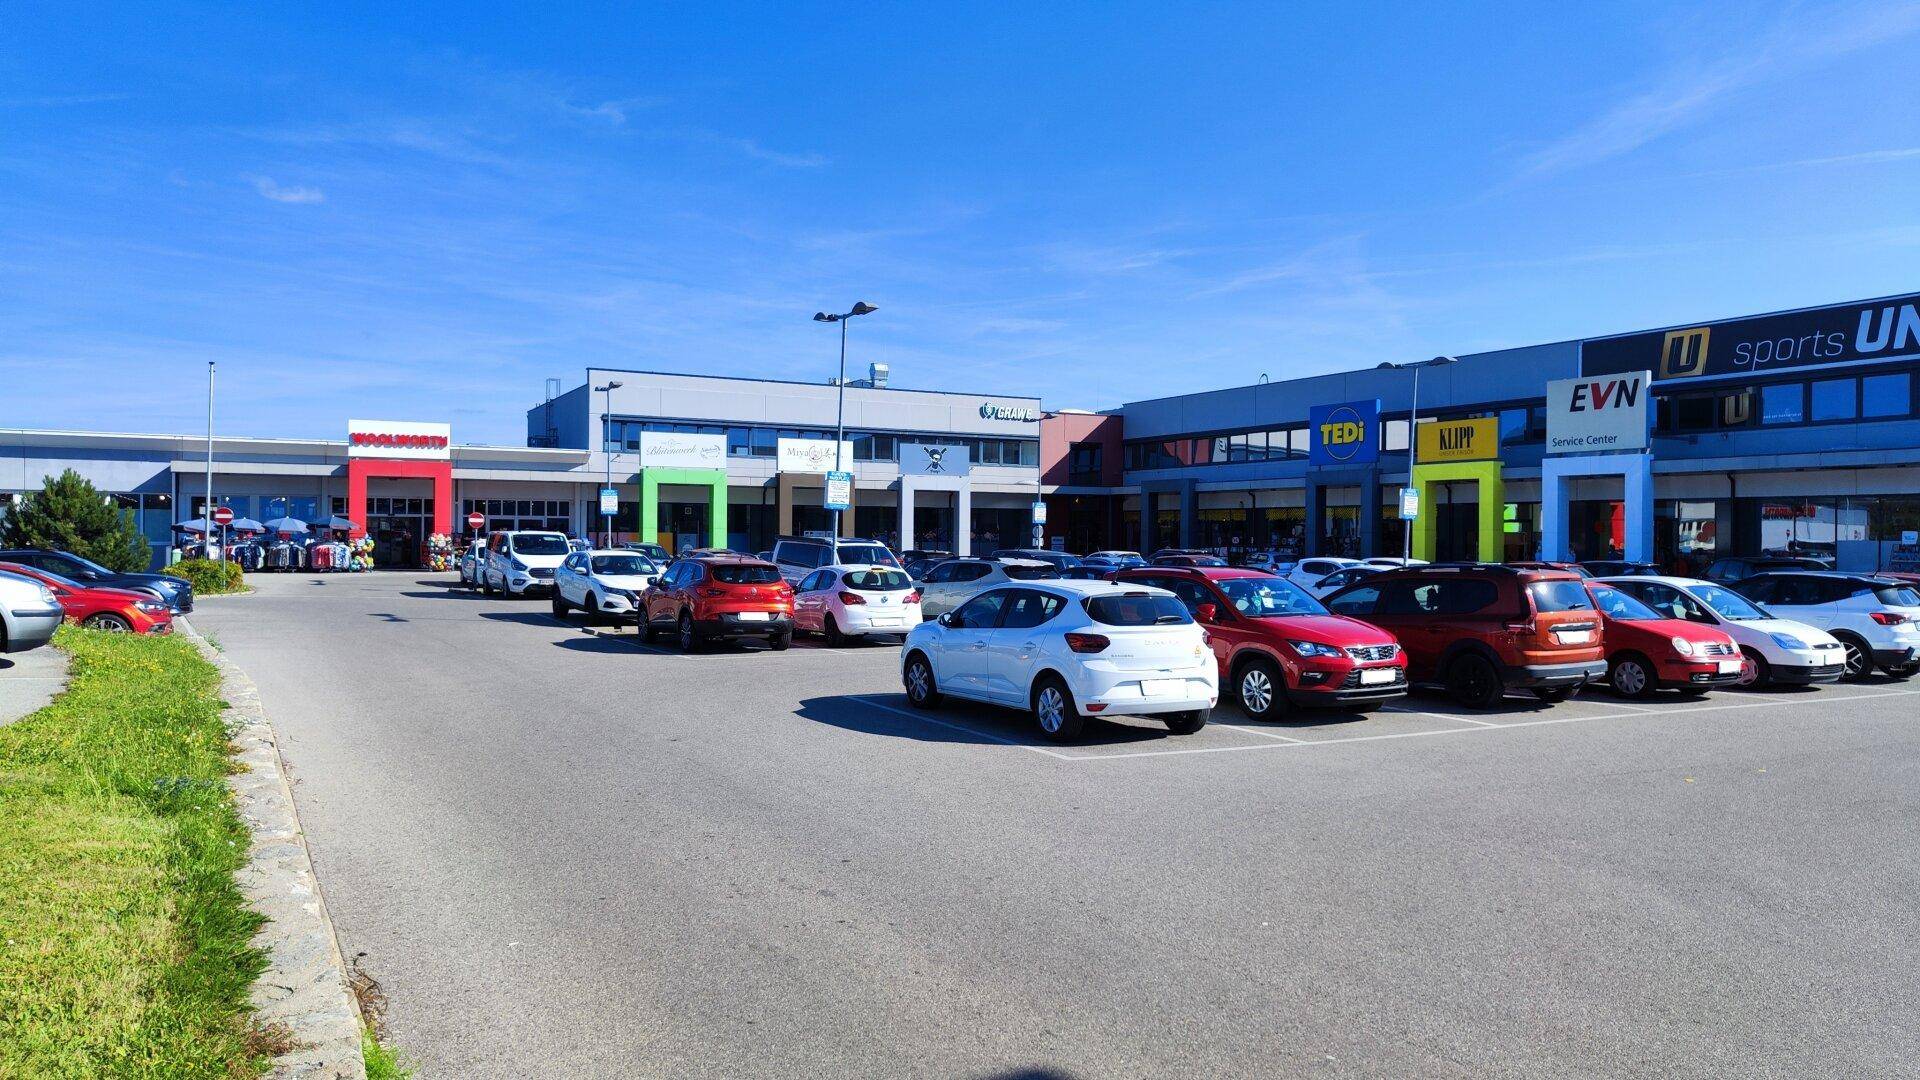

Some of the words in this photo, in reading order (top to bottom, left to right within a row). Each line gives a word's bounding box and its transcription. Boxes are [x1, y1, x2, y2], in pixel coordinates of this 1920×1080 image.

[1733, 330, 1845, 371] sports
[1569, 378, 1640, 413] EVN
[995, 406, 1034, 420] GRAWE
[349, 432, 448, 449] WOOLWORTH
[1320, 420, 1365, 445] TEDi
[1439, 425, 1475, 451] KLIPP
[1551, 436, 1584, 448] Service
[1586, 434, 1618, 446] Center
